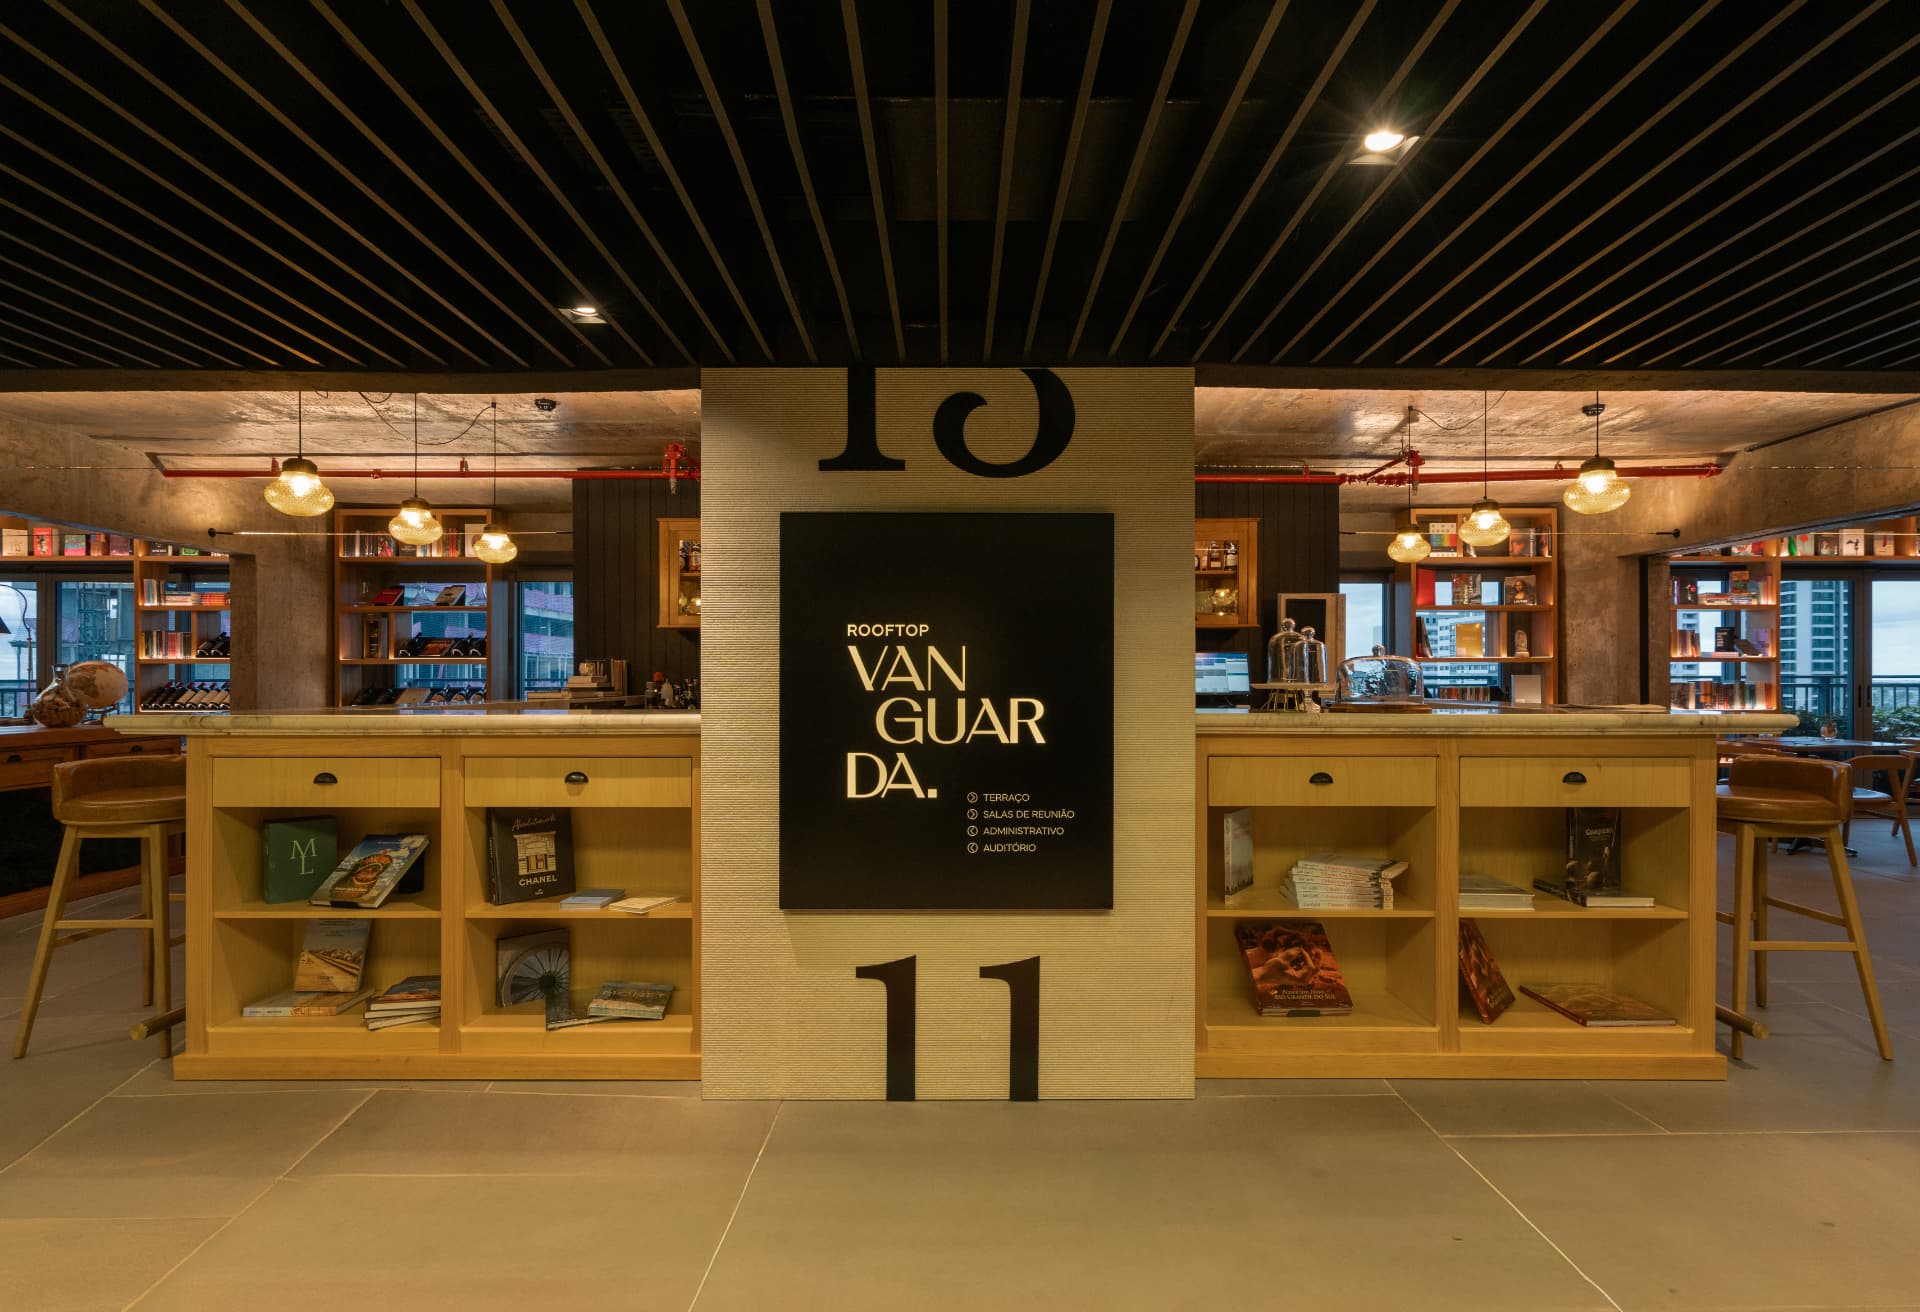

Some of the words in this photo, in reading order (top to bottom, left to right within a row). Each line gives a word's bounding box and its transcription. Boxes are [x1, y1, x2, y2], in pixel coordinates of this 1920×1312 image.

[847, 624, 929, 637] ROOFTOP
[848, 645, 966, 691] VAN
[875, 697, 1046, 744] GUAR
[847, 752, 938, 798] DA.
[983, 793, 1030, 804] TERRAÇO
[983, 810, 1014, 819] SALAS
[1016, 810, 1030, 819] DE
[1031, 808, 1075, 819] REUNIÃO
[983, 826, 1065, 836] ADMINISTRATIVO
[983, 842, 1037, 852] AUDITÓRIO
[519, 875, 558, 886] CHANEL
[856, 954, 1040, 1101] 11
